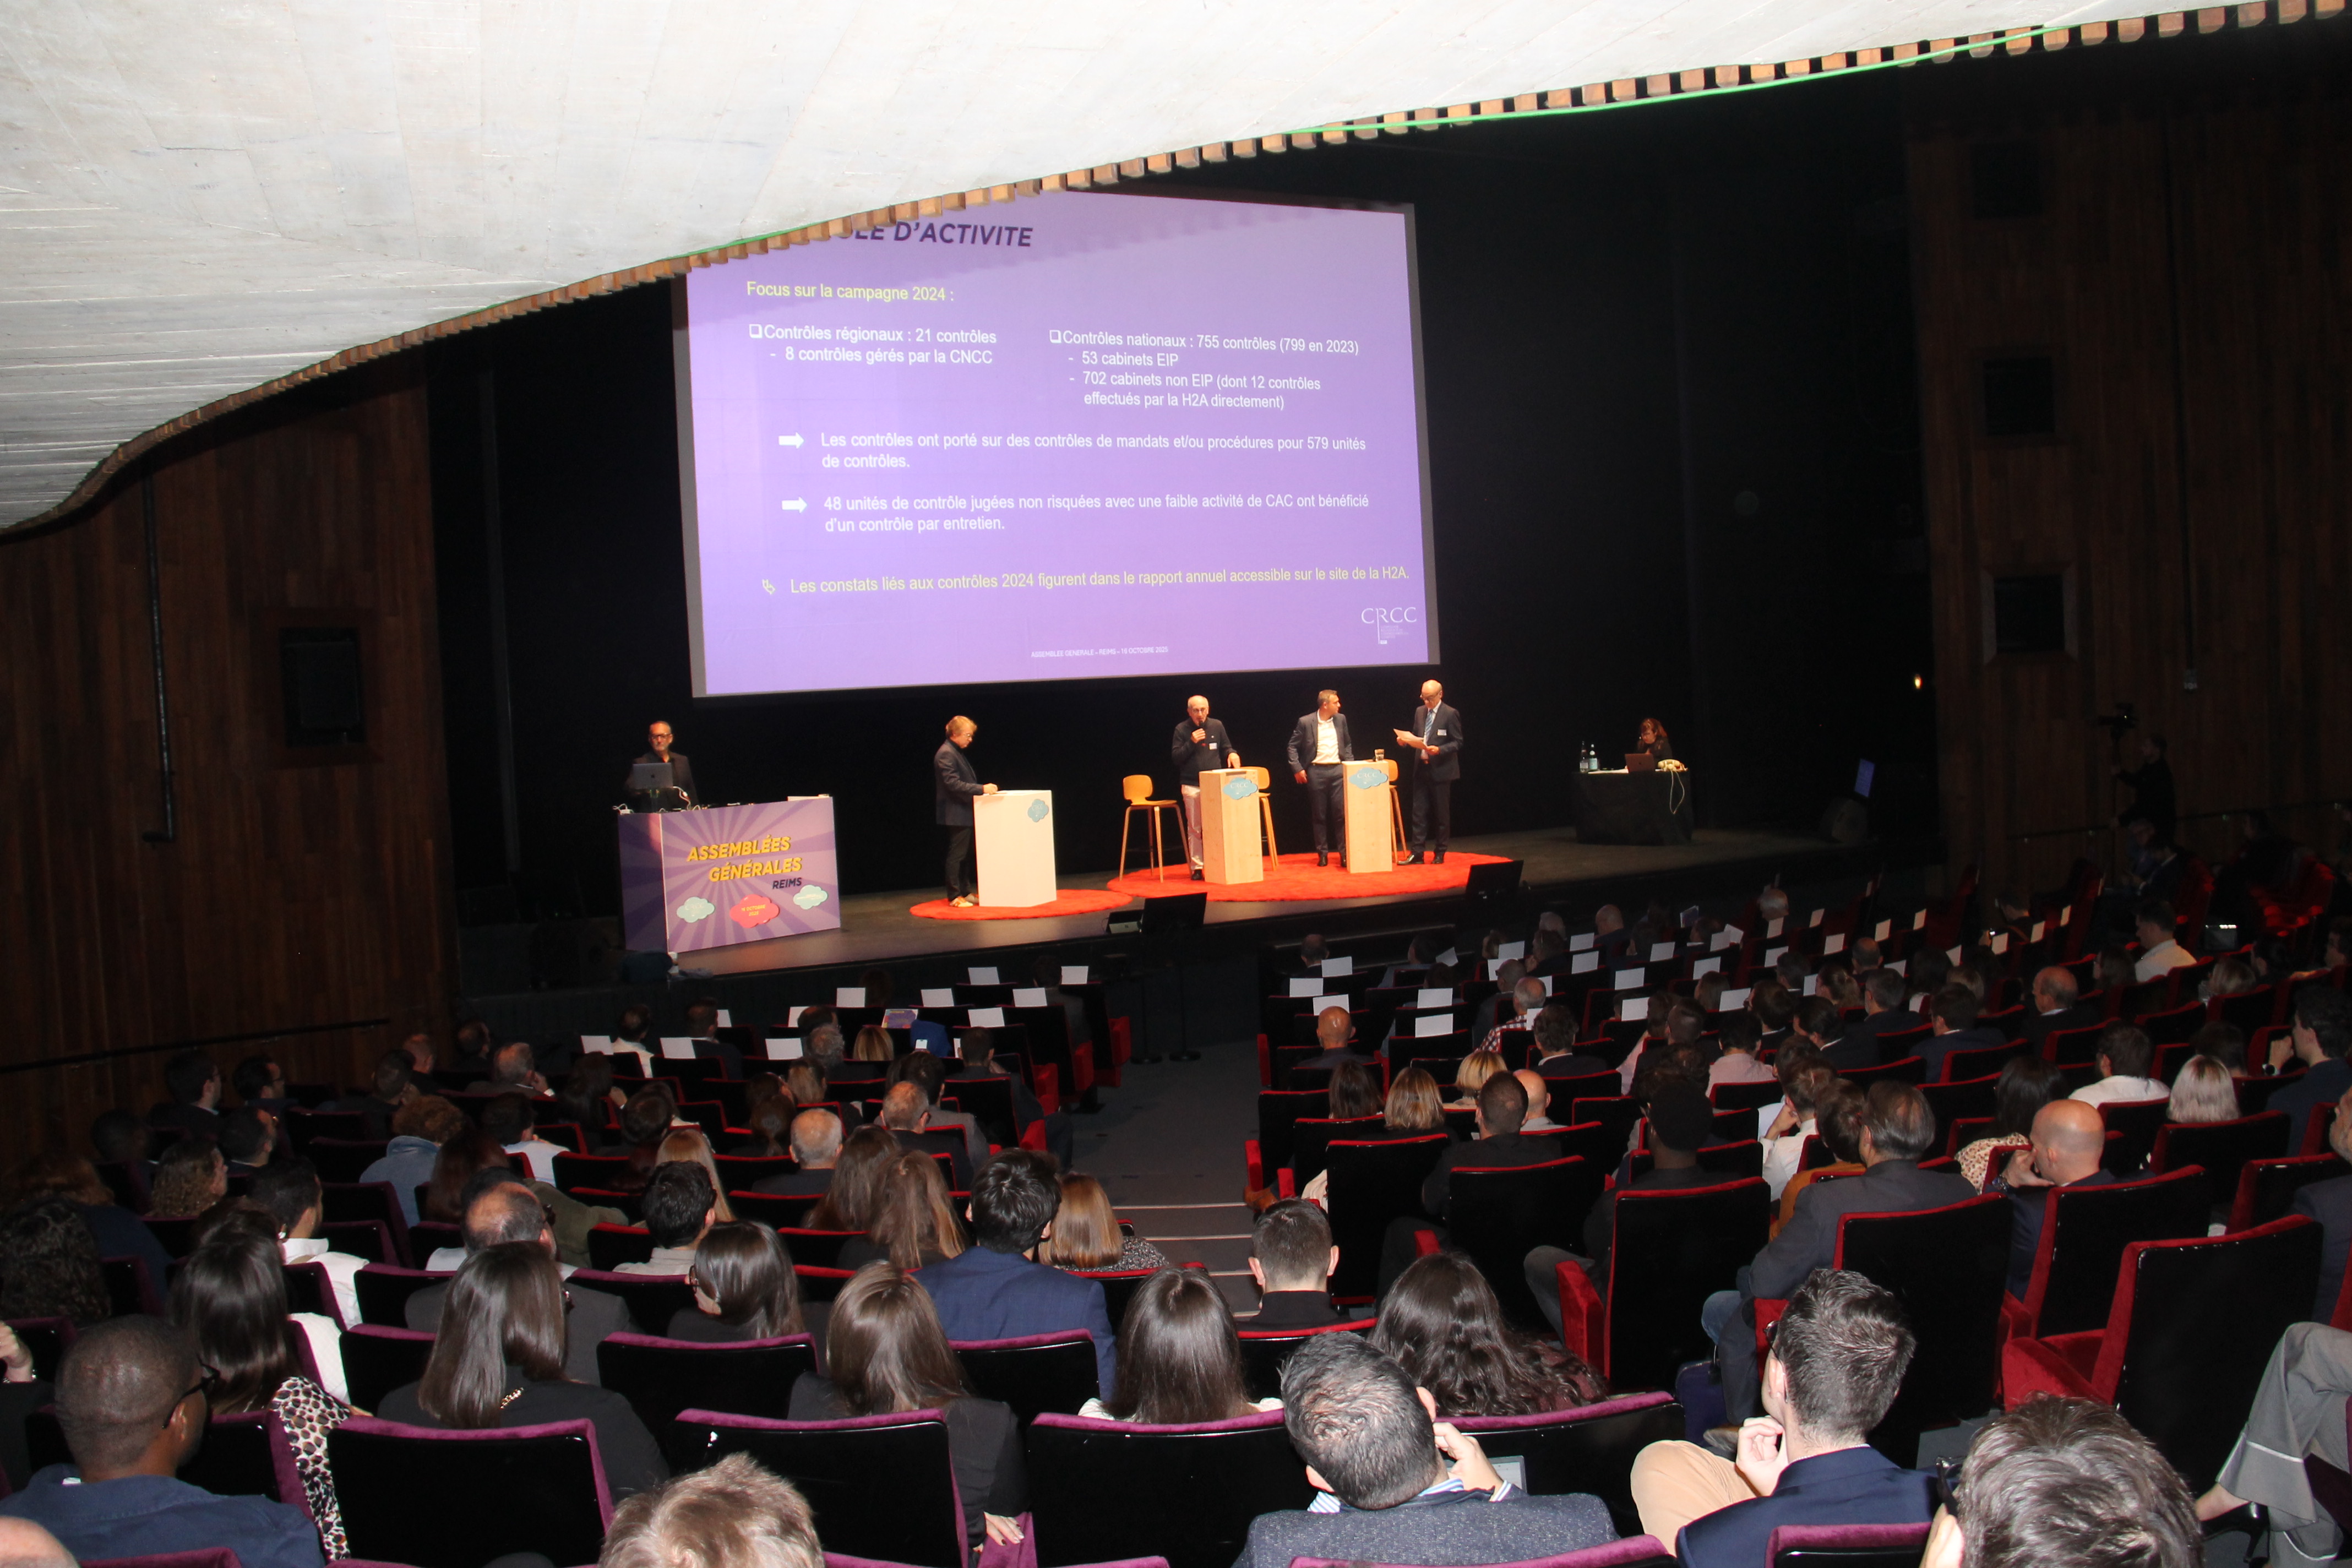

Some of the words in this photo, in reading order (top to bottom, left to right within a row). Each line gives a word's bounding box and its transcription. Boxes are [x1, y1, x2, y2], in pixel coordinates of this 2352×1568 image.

[747, 281, 791, 297] Focus
[794, 286, 817, 297] sur
[820, 283, 833, 298] la
[836, 287, 909, 303] campagne
[912, 286, 946, 301] 2024
[764, 324, 832, 340] Contrôles
[836, 326, 904, 344] régionaux
[915, 328, 931, 342] 21
[936, 329, 997, 344] contrôles
[1063, 330, 1124, 346] Contrôles
[1126, 333, 1186, 347] nationaux
[1196, 334, 1219, 349] 755
[1222, 336, 1277, 351] contrôles
[1280, 337, 1305, 353] (799
[1308, 341, 1323, 352] en
[1326, 339, 1359, 356] 2023)
[785, 346, 795, 361] 8
[798, 347, 862, 362] contrôles
[865, 347, 905, 365] gérés
[908, 351, 931, 366] par
[934, 349, 946, 363] la
[950, 349, 993, 364] CNCC
[1082, 350, 1098, 365] 53
[1101, 351, 1153, 366] cabinets
[1157, 352, 1179, 367] EIP
[1082, 371, 1107, 385] 702
[1110, 372, 1162, 386] cabinets
[1165, 376, 1188, 386] non
[1191, 373, 1213, 387] EIP
[1216, 374, 1248, 390] (dont
[1251, 375, 1265, 389] 12
[1268, 377, 1321, 390] contrôles
[1084, 391, 1141, 406] effectués
[1144, 395, 1164, 409] par
[1167, 393, 1179, 406] la
[1182, 393, 1209, 407] H2A
[1211, 394, 1284, 411] directement)
[821, 432, 847, 447] Les
[851, 432, 913, 447] contrôles
[917, 433, 940, 447] ont
[943, 433, 978, 450] porté
[982, 436, 1003, 447] sur
[1006, 433, 1031, 447] des
[1034, 433, 1093, 448] contrôles
[1096, 434, 1113, 448] de
[1117, 434, 1169, 448] mandats
[1173, 434, 1204, 448] et/ou
[1207, 435, 1274, 451] procédures
[1277, 439, 1304, 452] pour
[1307, 436, 1329, 450] 579
[1332, 437, 1366, 450] unités
[821, 454, 840, 468] de
[843, 453, 910, 468] contrôles.
[824, 496, 842, 510] 48
[846, 496, 888, 510] unités
[891, 496, 909, 510] de
[913, 495, 967, 510] contrôle
[970, 495, 1015, 512] jugées
[1019, 498, 1043, 509] non
[1047, 494, 1101, 511] risquées
[1105, 497, 1135, 508] avec
[1138, 497, 1162, 508] une
[1165, 494, 1198, 508] faible
[1202, 494, 1244, 508] activité
[1247, 494, 1262, 507] de
[1265, 494, 1293, 507] CAC
[1297, 494, 1316, 507] ont
[1318, 494, 1369, 507] bénéficié
[858, 516, 914, 531] contrôle
[917, 519, 940, 533] par
[943, 515, 1005, 530] entretien.
[791, 579, 816, 594] Les
[820, 578, 879, 592] constats
[882, 576, 906, 590] liés
[909, 579, 934, 590] aux
[938, 574, 998, 589] contrôles
[1001, 573, 1034, 587] 2024
[1038, 573, 1086, 590] figurent
[1090, 571, 1120, 585] dans
[1124, 571, 1135, 584] le
[1139, 570, 1183, 587] rapport
[1185, 569, 1227, 583] annuel
[1229, 568, 1291, 582] accessible
[1294, 570, 1313, 581] sur
[1315, 567, 1326, 580] le
[1329, 567, 1349, 580] site
[1352, 567, 1366, 580] de
[1369, 567, 1379, 579] la
[1382, 566, 1409, 579] H2A.
[687, 835, 791, 862] ASSEMBLÉES
[709, 857, 803, 882] GÉNÉRALES
[772, 878, 802, 889] REIMS
